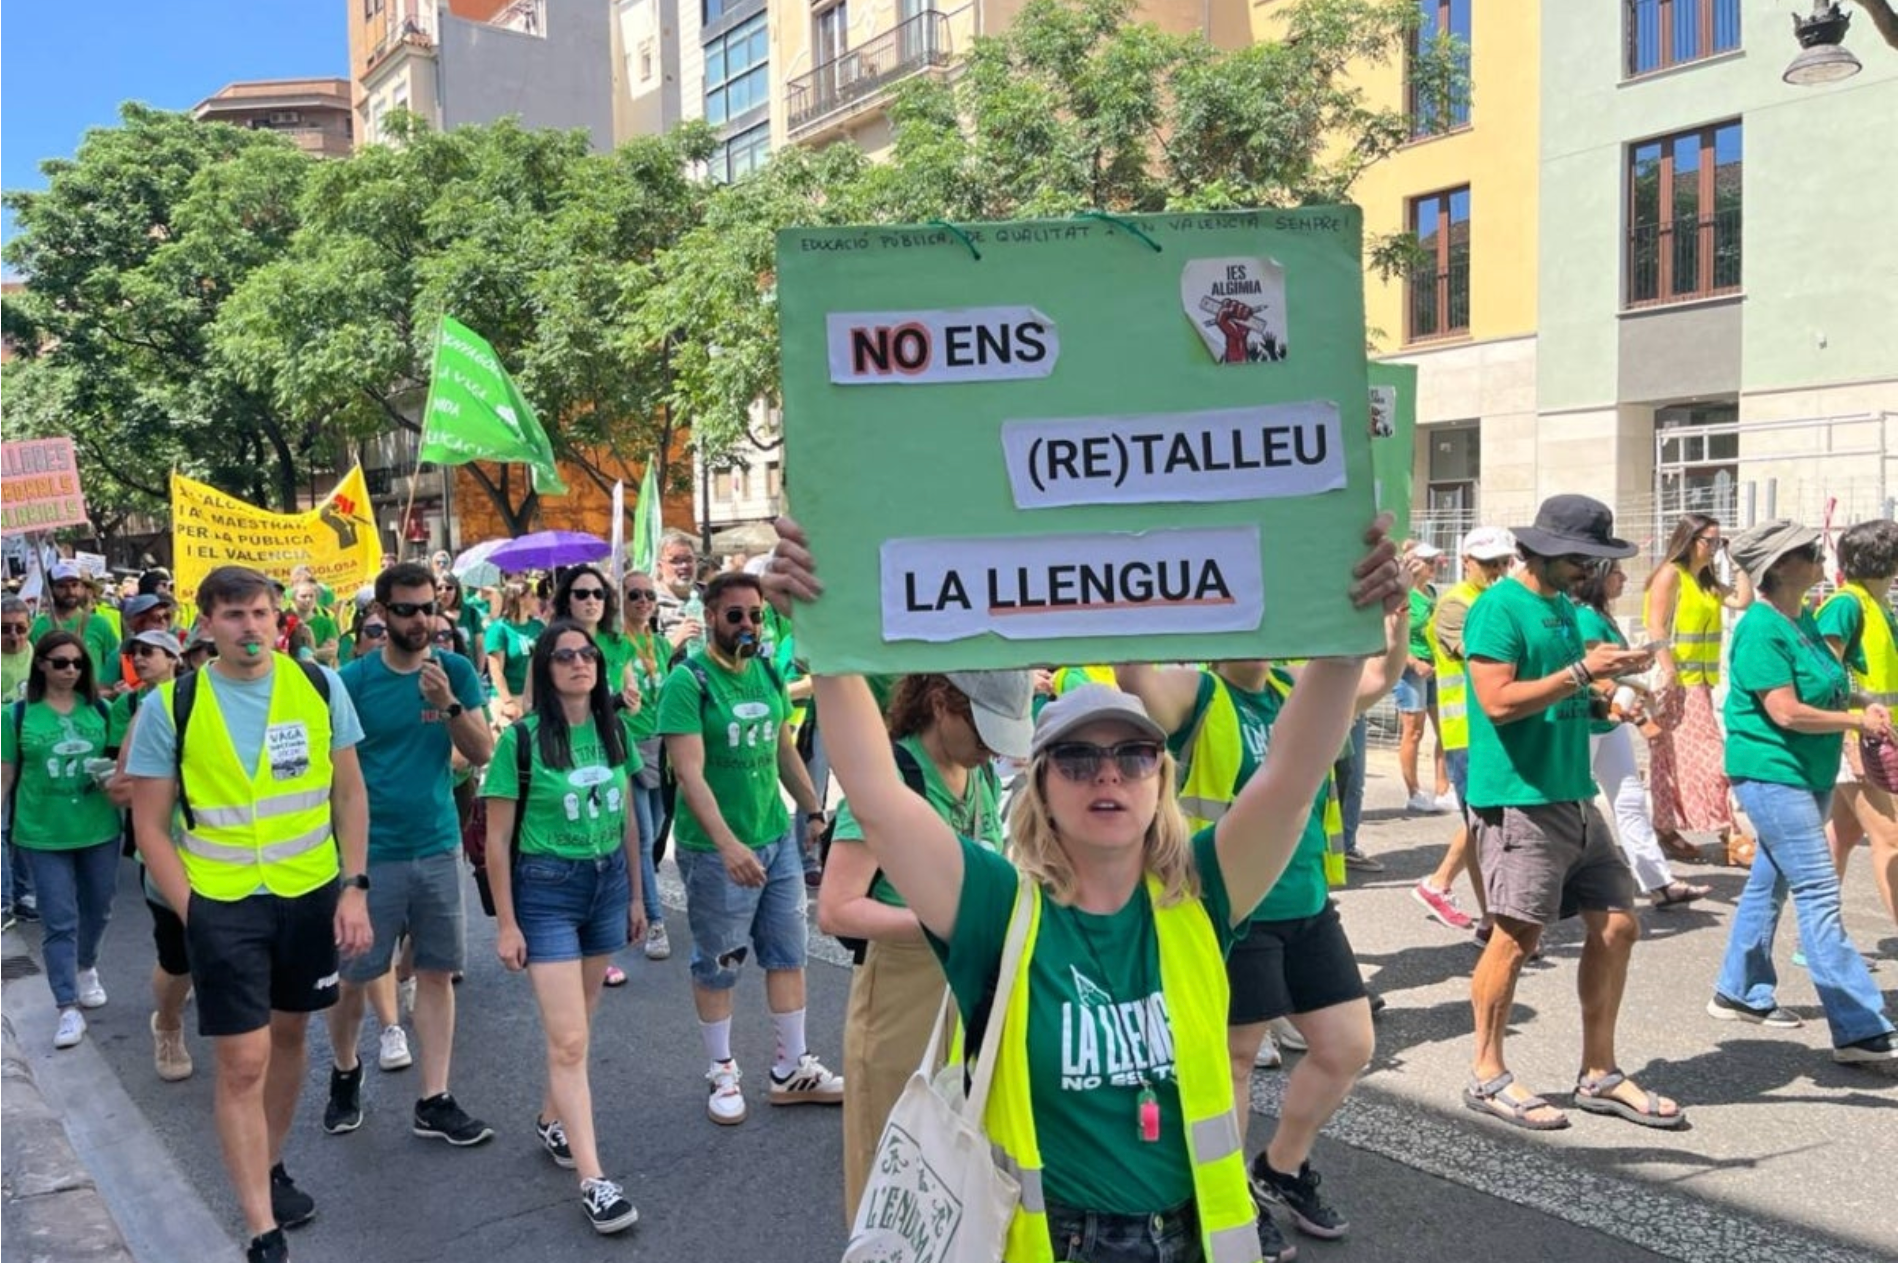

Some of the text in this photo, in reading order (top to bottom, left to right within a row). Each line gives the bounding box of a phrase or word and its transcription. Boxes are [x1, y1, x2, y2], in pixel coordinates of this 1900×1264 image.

[801, 230, 869, 251] EDUCACIÓ
[996, 226, 1090, 243] QUALITAT
[1226, 264, 1247, 280] IES
[1211, 279, 1262, 297] ALGIMIA
[852, 321, 1047, 372] NO ENS
[1028, 423, 1328, 492] (RE)TALLEU
[177, 524, 209, 539] PER
[197, 546, 220, 560] EL
[905, 558, 1231, 612] LA LLENGUA
[1061, 1001, 1100, 1075] LA
[1061, 1076, 1102, 1092] NO
